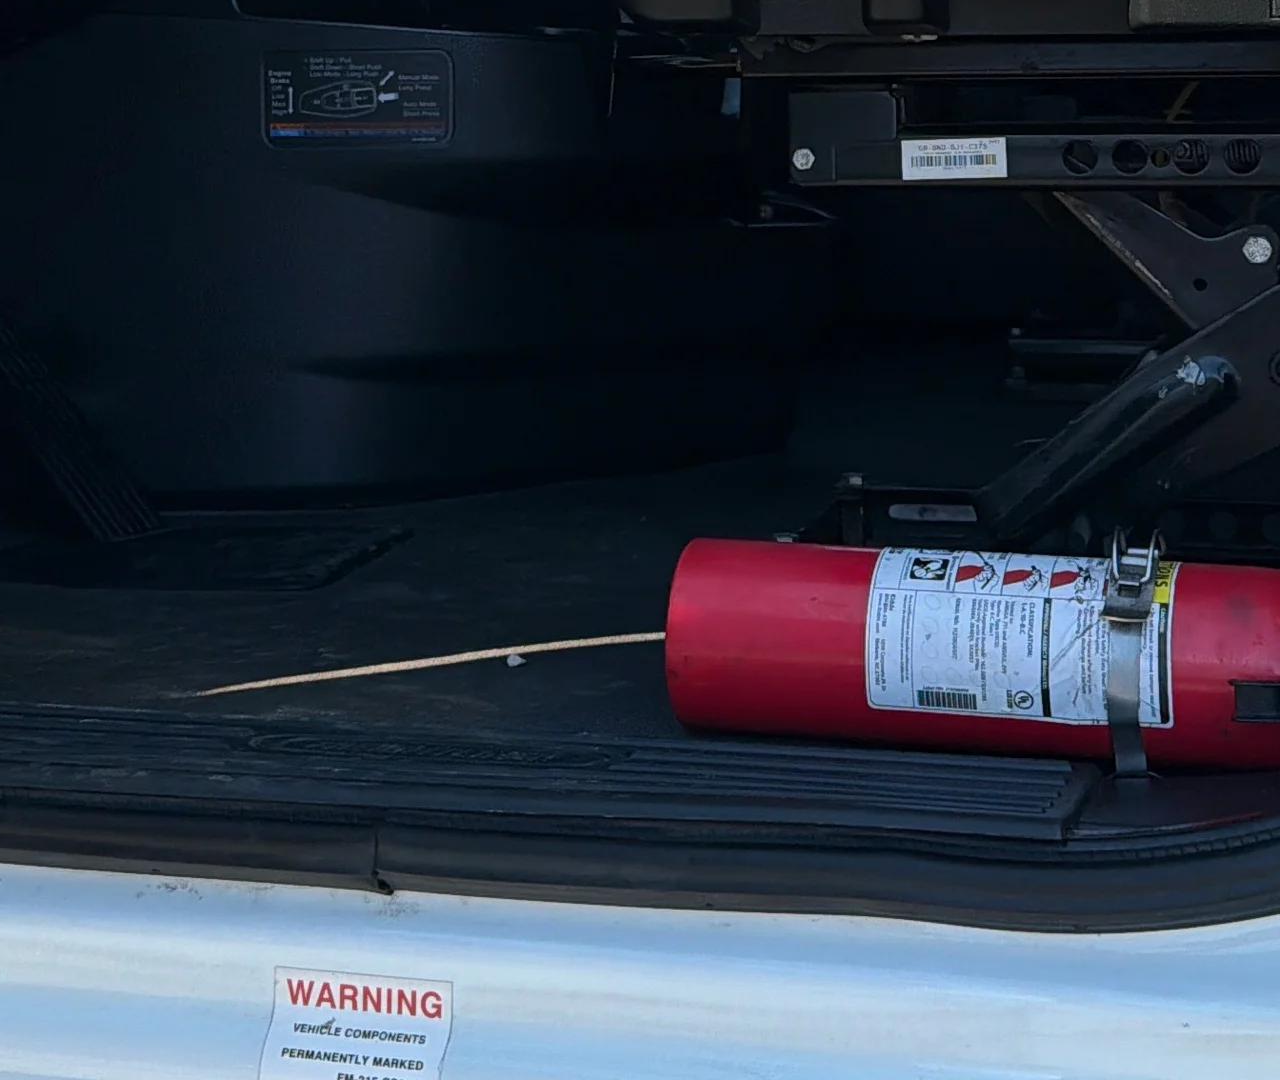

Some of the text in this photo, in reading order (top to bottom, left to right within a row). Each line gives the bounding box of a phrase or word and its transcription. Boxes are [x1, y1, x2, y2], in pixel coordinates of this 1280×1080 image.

[287, 978, 442, 1019] WARNING
[293, 1023, 427, 1045] VEHICLE COMPONENTS
[281, 1047, 424, 1071] PERMANENTLY MARKED
